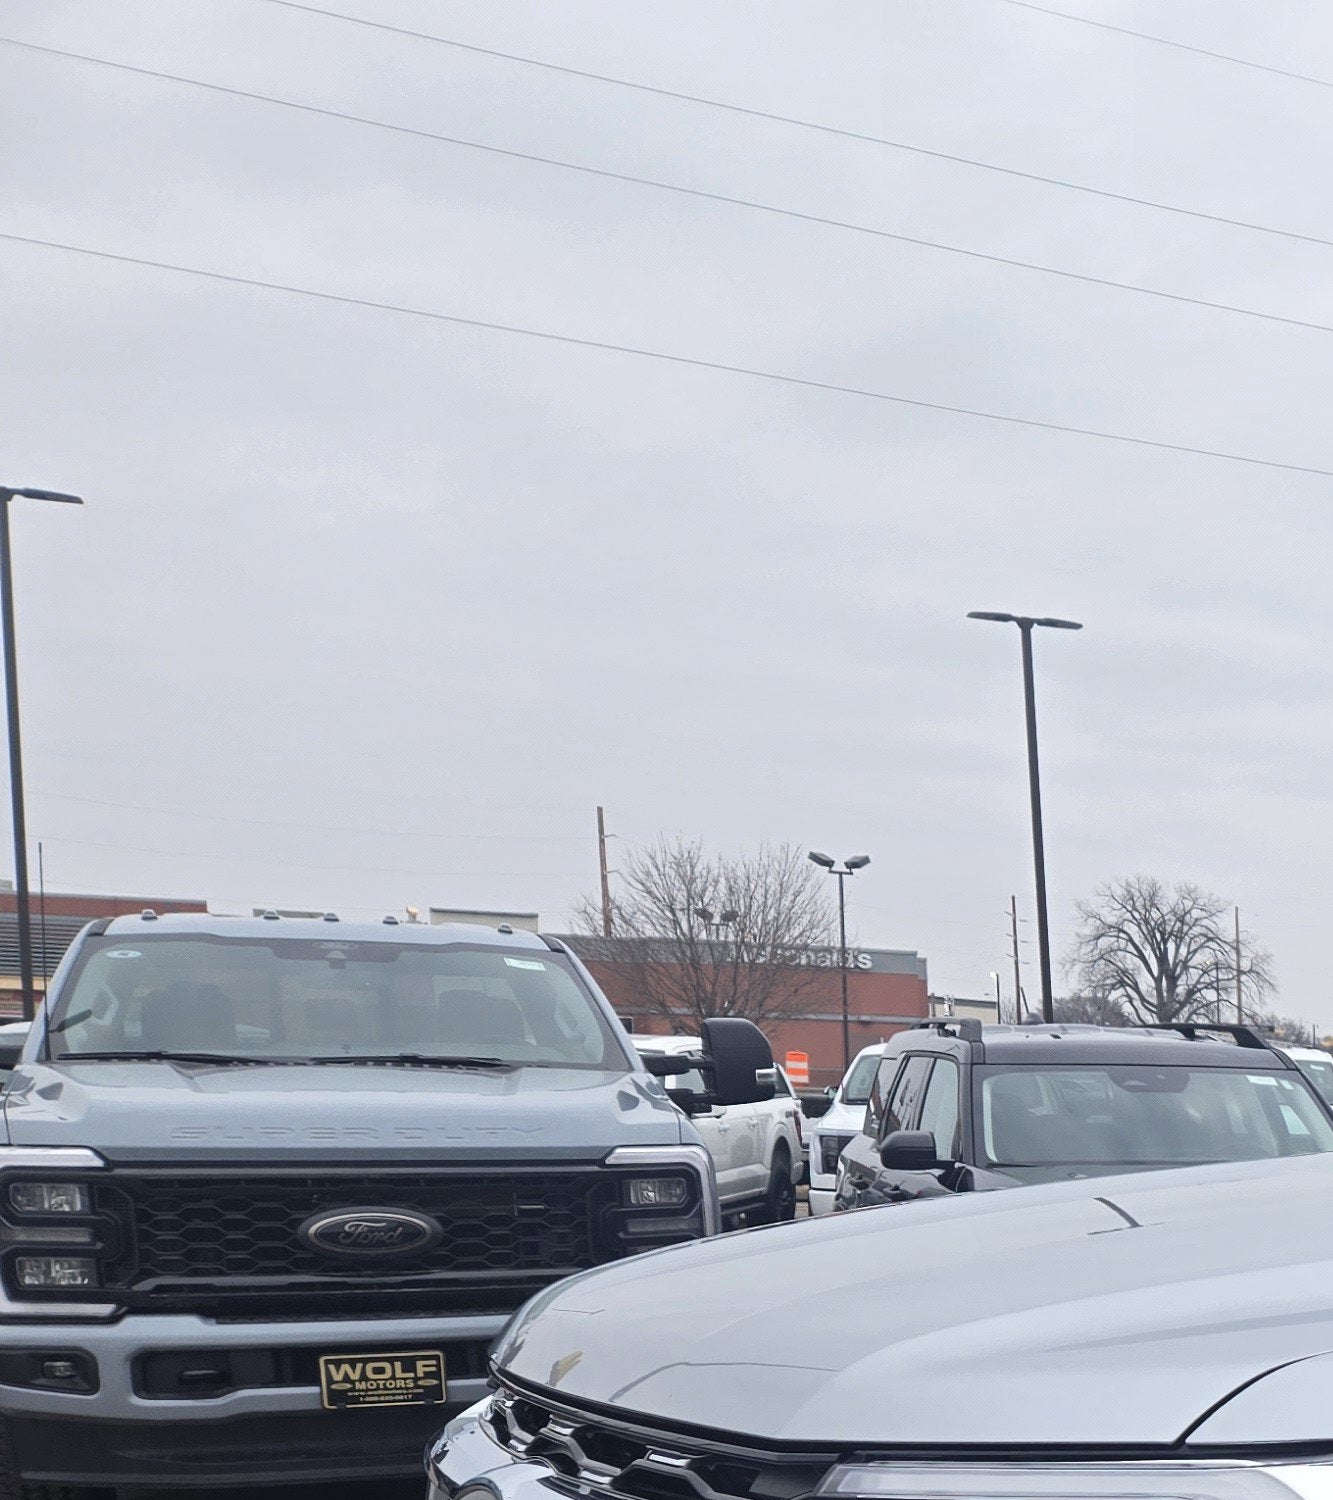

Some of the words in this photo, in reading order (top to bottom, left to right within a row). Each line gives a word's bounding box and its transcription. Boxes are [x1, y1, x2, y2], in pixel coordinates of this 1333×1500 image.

[338, 1220, 405, 1245] Ford
[327, 1360, 438, 1382] WOLF
[355, 1379, 415, 1390] MOTORS
